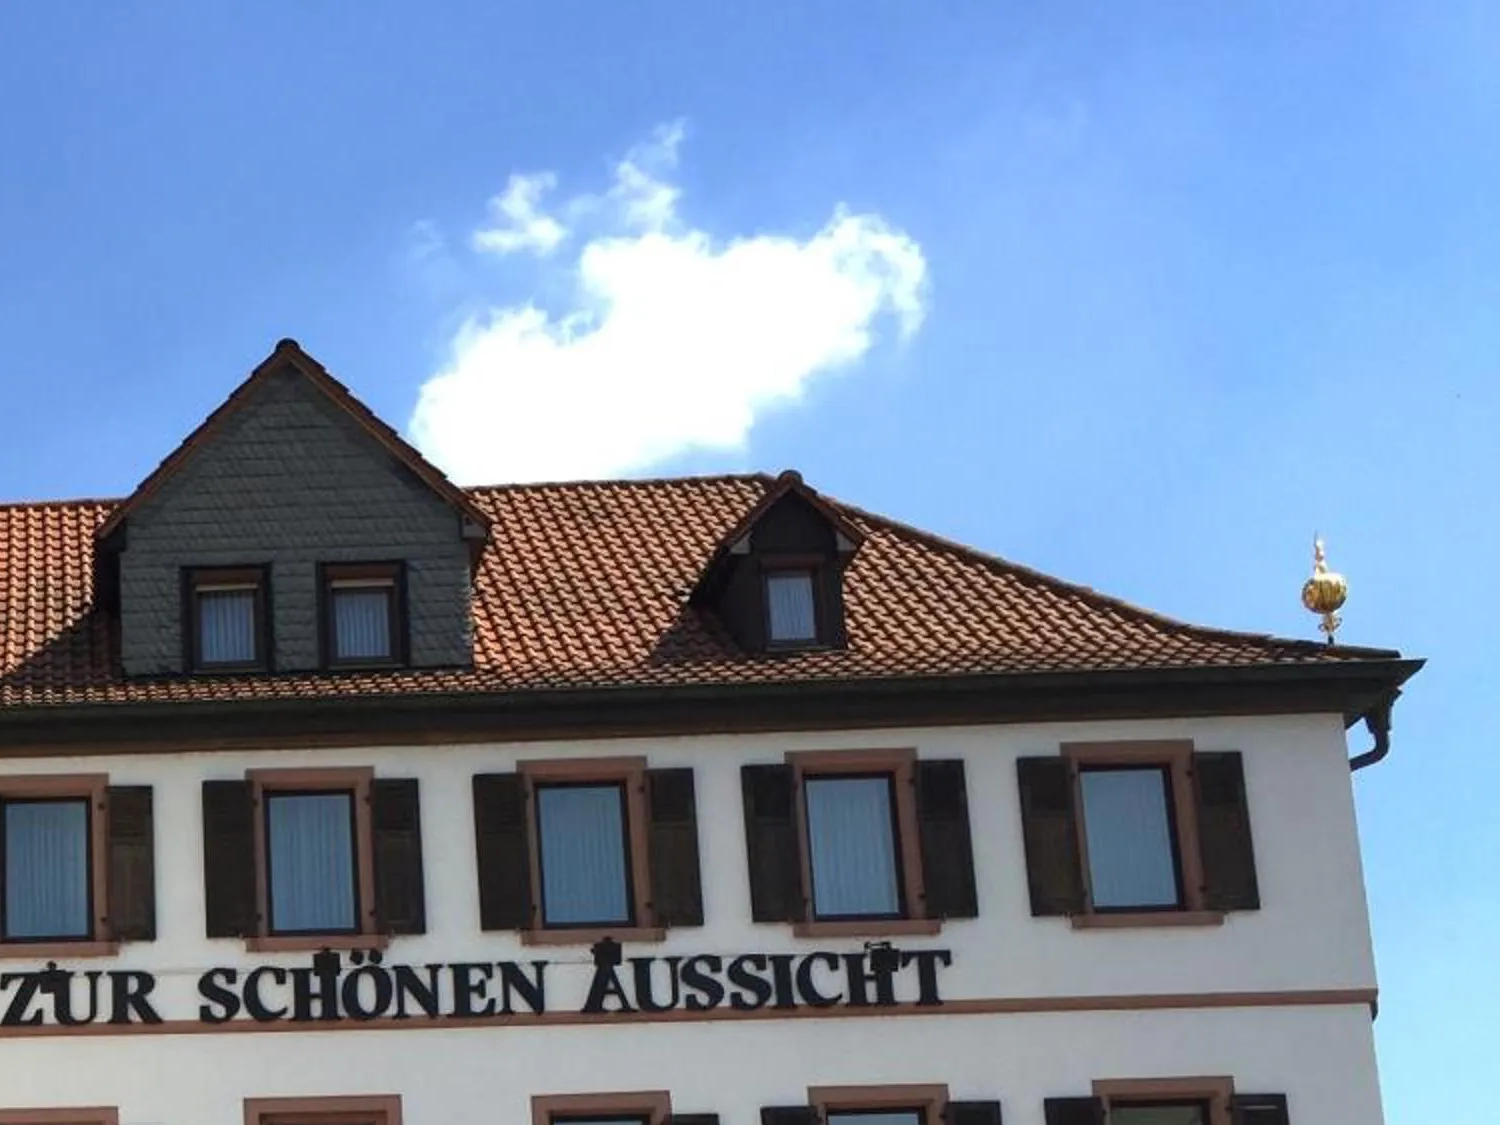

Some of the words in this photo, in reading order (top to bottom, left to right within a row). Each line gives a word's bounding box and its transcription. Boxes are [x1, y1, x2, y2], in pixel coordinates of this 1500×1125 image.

[0, 970, 164, 1026] ZUR
[198, 950, 548, 1023] SCHÖNEN
[580, 949, 952, 1013] AUSSICHT
